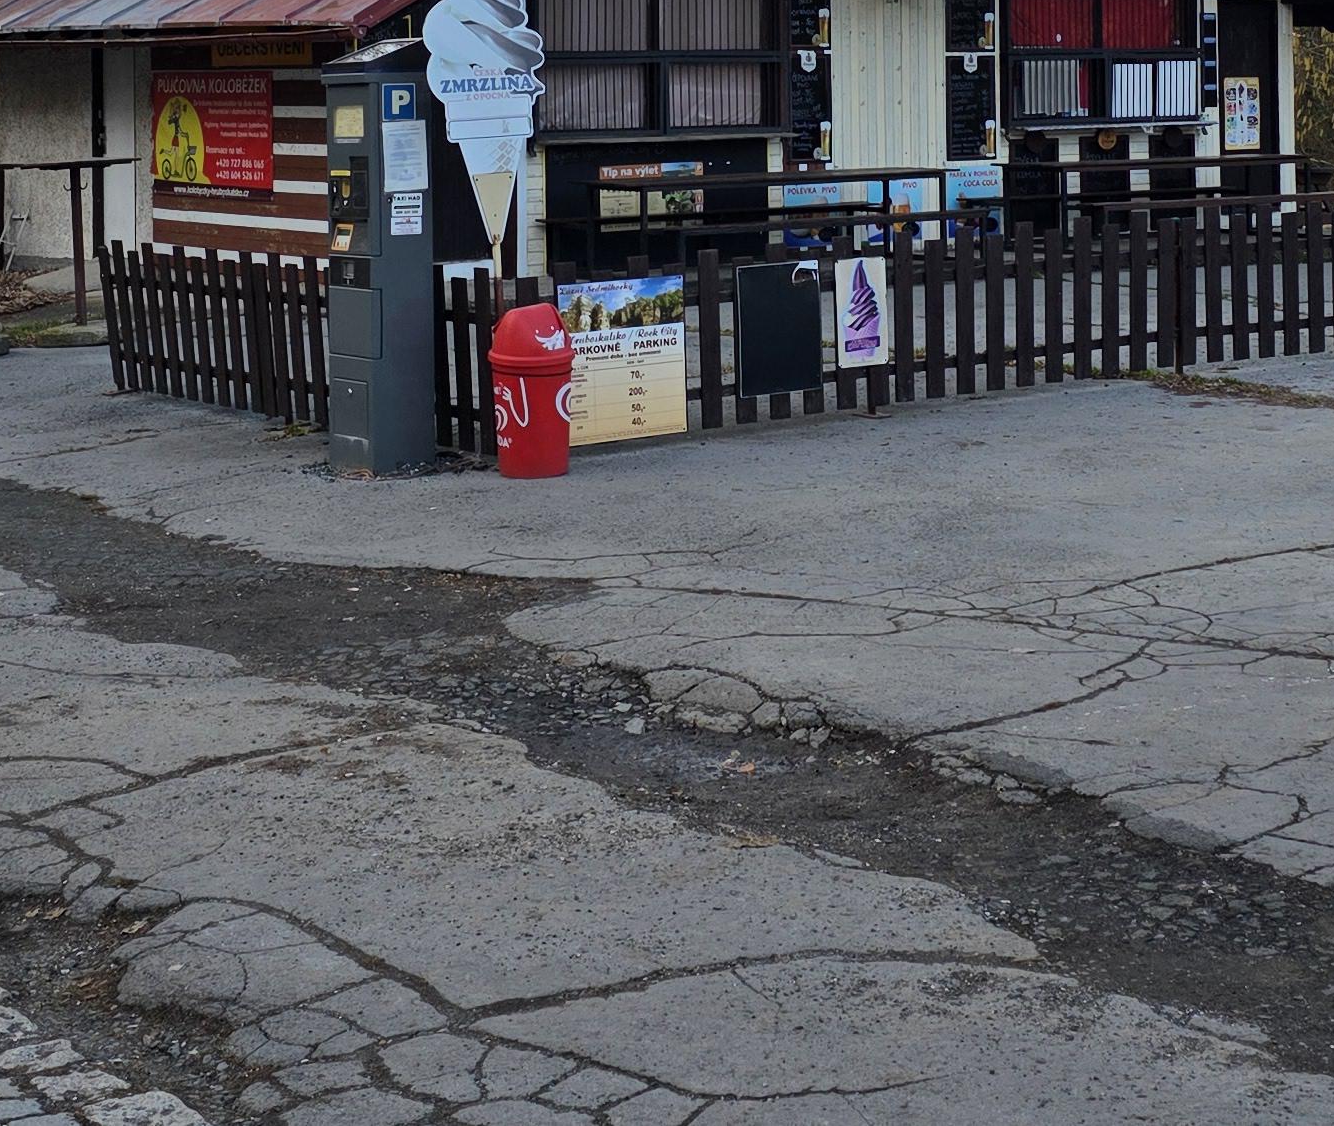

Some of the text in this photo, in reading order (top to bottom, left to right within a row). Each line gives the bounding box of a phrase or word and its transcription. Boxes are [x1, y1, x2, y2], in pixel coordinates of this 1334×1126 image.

[157, 75, 267, 94] PŮJČOVNA KOLOBĚŽEK
[440, 75, 533, 93] ZMRZLINA
[392, 90, 410, 114] P
[216, 158, 229, 168] +420
[230, 159, 241, 168] 727
[216, 171, 229, 179] +420
[602, 165, 659, 178] Tip na výlet
[963, 179, 980, 187] COCA
[821, 186, 837, 194] PIVO
[636, 327, 658, 338] Rock
[660, 326, 678, 336] City
[573, 337, 678, 356] ARKOVNÉ PARKING
[630, 370, 645, 380] 70,-
[628, 387, 648, 396] 200,-
[631, 403, 646, 413] 50,-
[632, 417, 647, 426] 40,-
